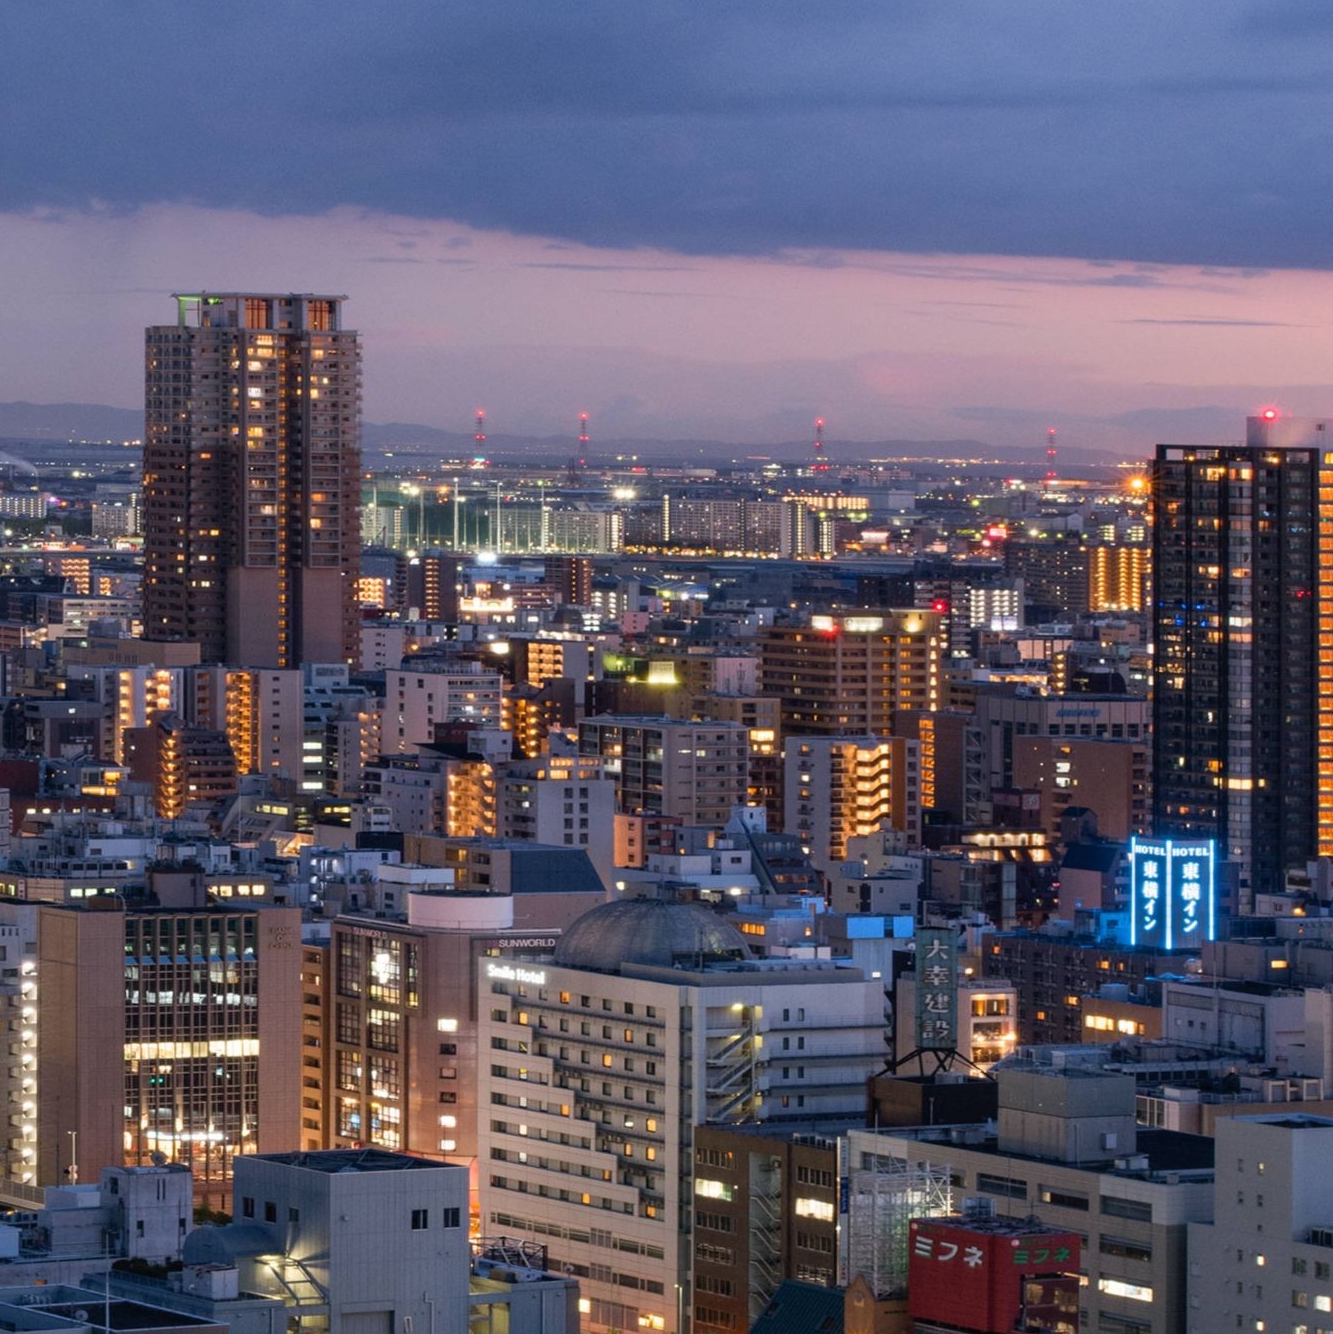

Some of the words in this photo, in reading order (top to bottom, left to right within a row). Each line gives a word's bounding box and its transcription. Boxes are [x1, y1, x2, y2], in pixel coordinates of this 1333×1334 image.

[1135, 845, 1166, 856] HOTEL
[1172, 847, 1210, 857] HOTEL
[1142, 860, 1159, 931] 東横イン
[1181, 862, 1201, 933] 東横イン
[499, 938, 556, 948] SUNWORLD
[487, 964, 515, 980] Smile
[516, 968, 546, 985] Hotel
[923, 937, 951, 1040] 大幸建設
[915, 1235, 983, 1268] ミフネ
[1012, 1248, 1070, 1264] ミフネ
